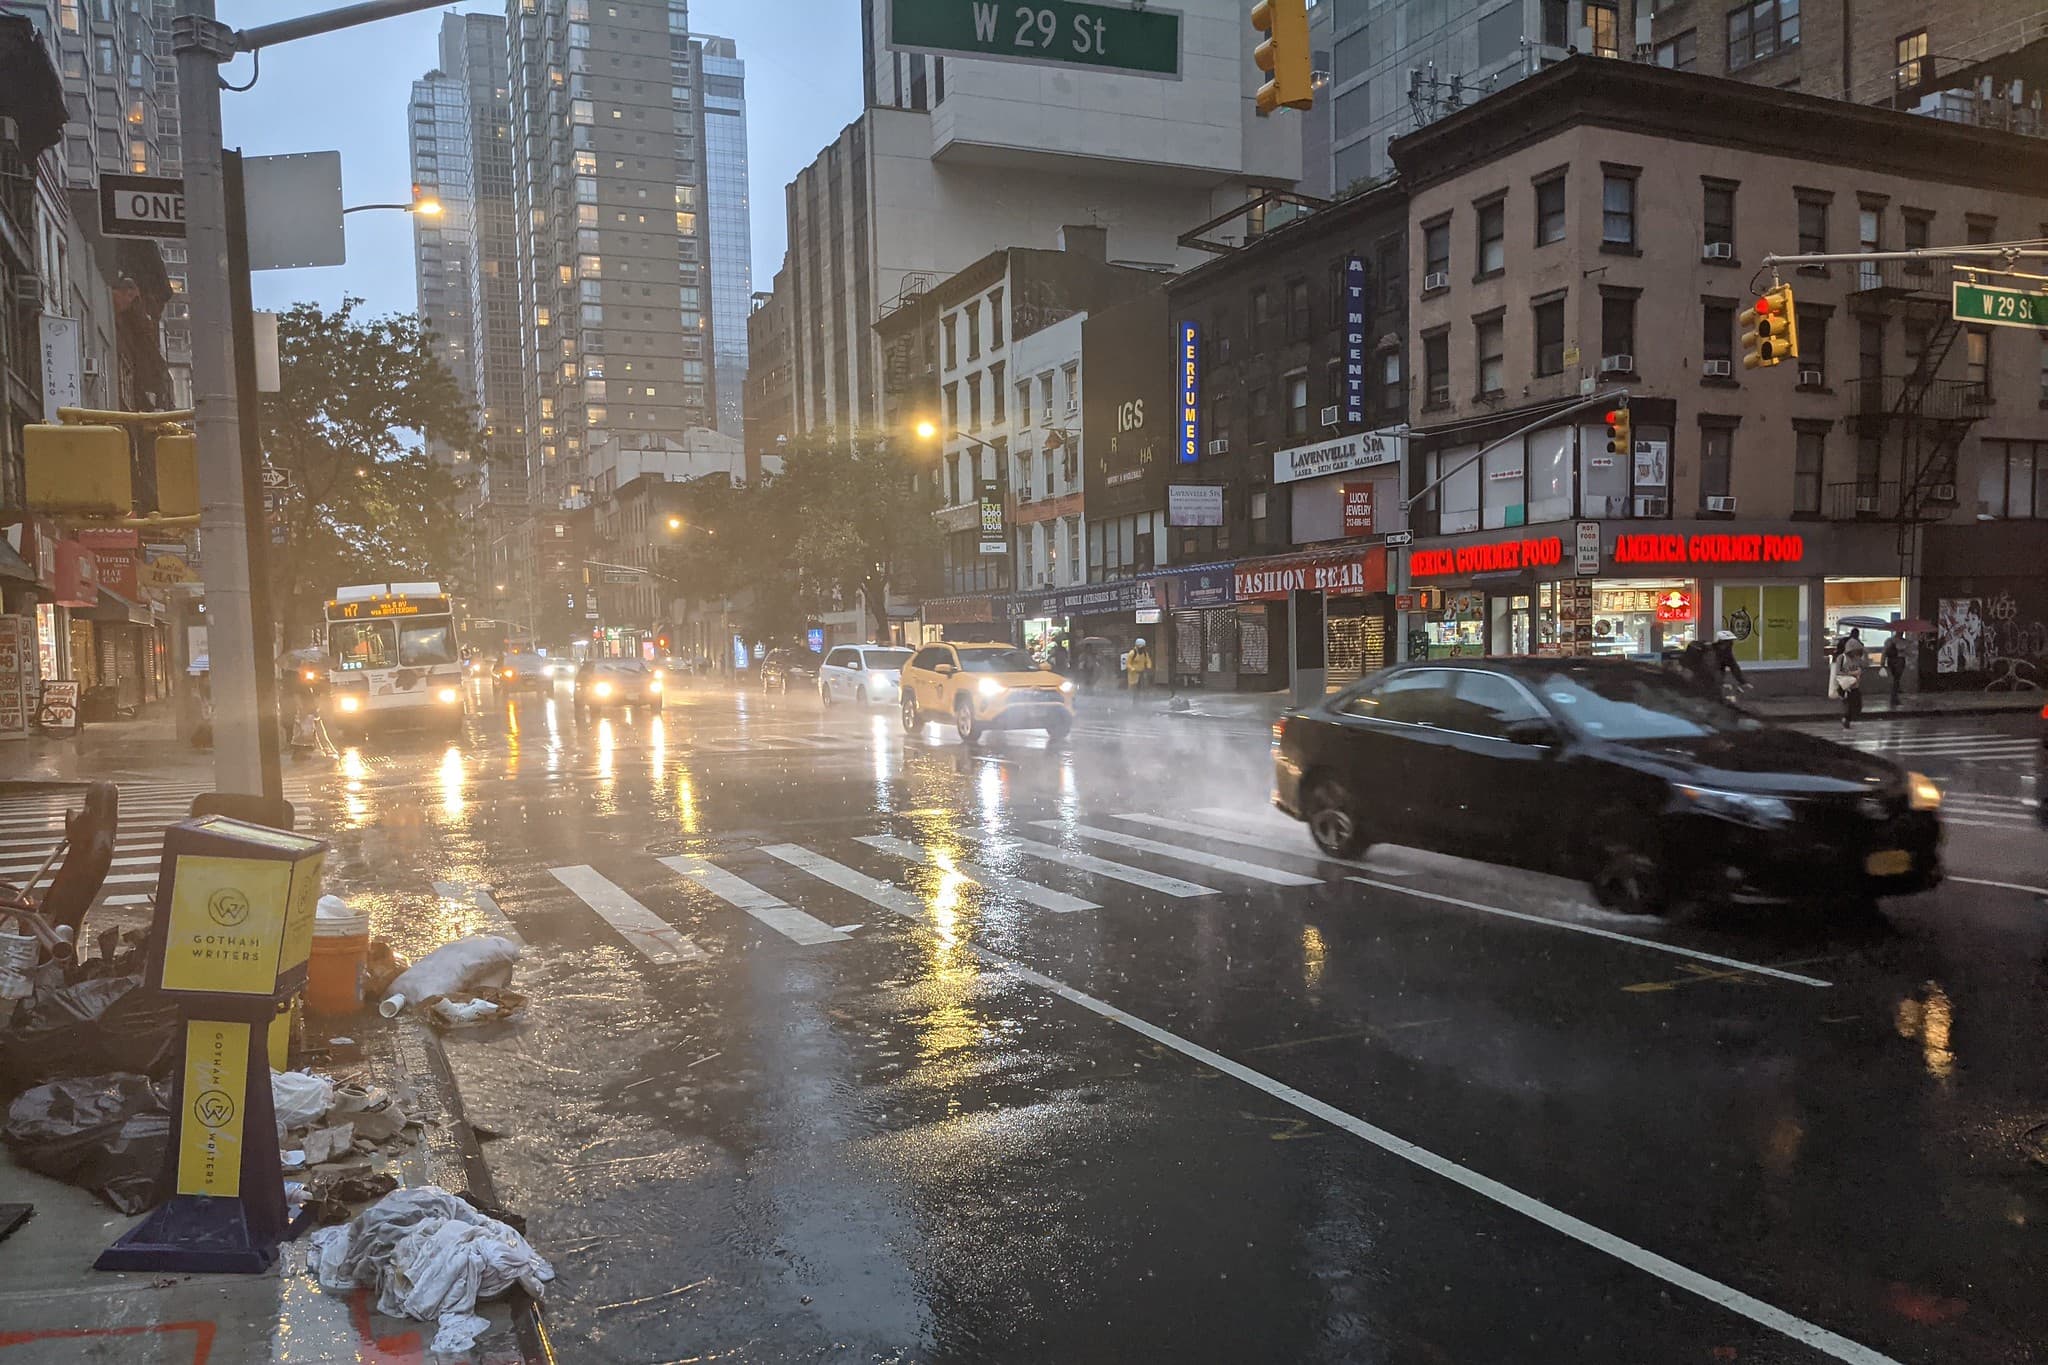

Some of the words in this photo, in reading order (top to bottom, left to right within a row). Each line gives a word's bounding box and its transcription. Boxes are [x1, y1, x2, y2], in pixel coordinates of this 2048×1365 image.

[972, 1, 999, 43] W
[1014, 6, 1057, 49] 29
[1072, 13, 1107, 56] St
[131, 194, 185, 220] ONE
[1983, 294, 1994, 316] W
[1997, 295, 2015, 318] 29
[2019, 298, 2033, 320] St
[46, 343, 56, 397] HEALING
[1348, 332, 1363, 423] CENTER
[1185, 327, 1197, 455] PERFUMES
[1345, 504, 1372, 517] JEWELRY
[1349, 492, 1369, 504] LUCKY
[1521, 536, 1563, 568] FOOD
[1615, 534, 1687, 563] AMERICA
[1688, 534, 1763, 563] GOURMET
[1763, 534, 1804, 562] FOOD
[1234, 567, 1306, 594] FASHION
[1314, 563, 1365, 589] BEAR
[344, 603, 359, 617] M7
[192, 950, 260, 961] WRITERS
[193, 934, 260, 948] GOTHAM
[211, 1032, 224, 1085] GOTHAM
[205, 1132, 217, 1185] WRITERS
